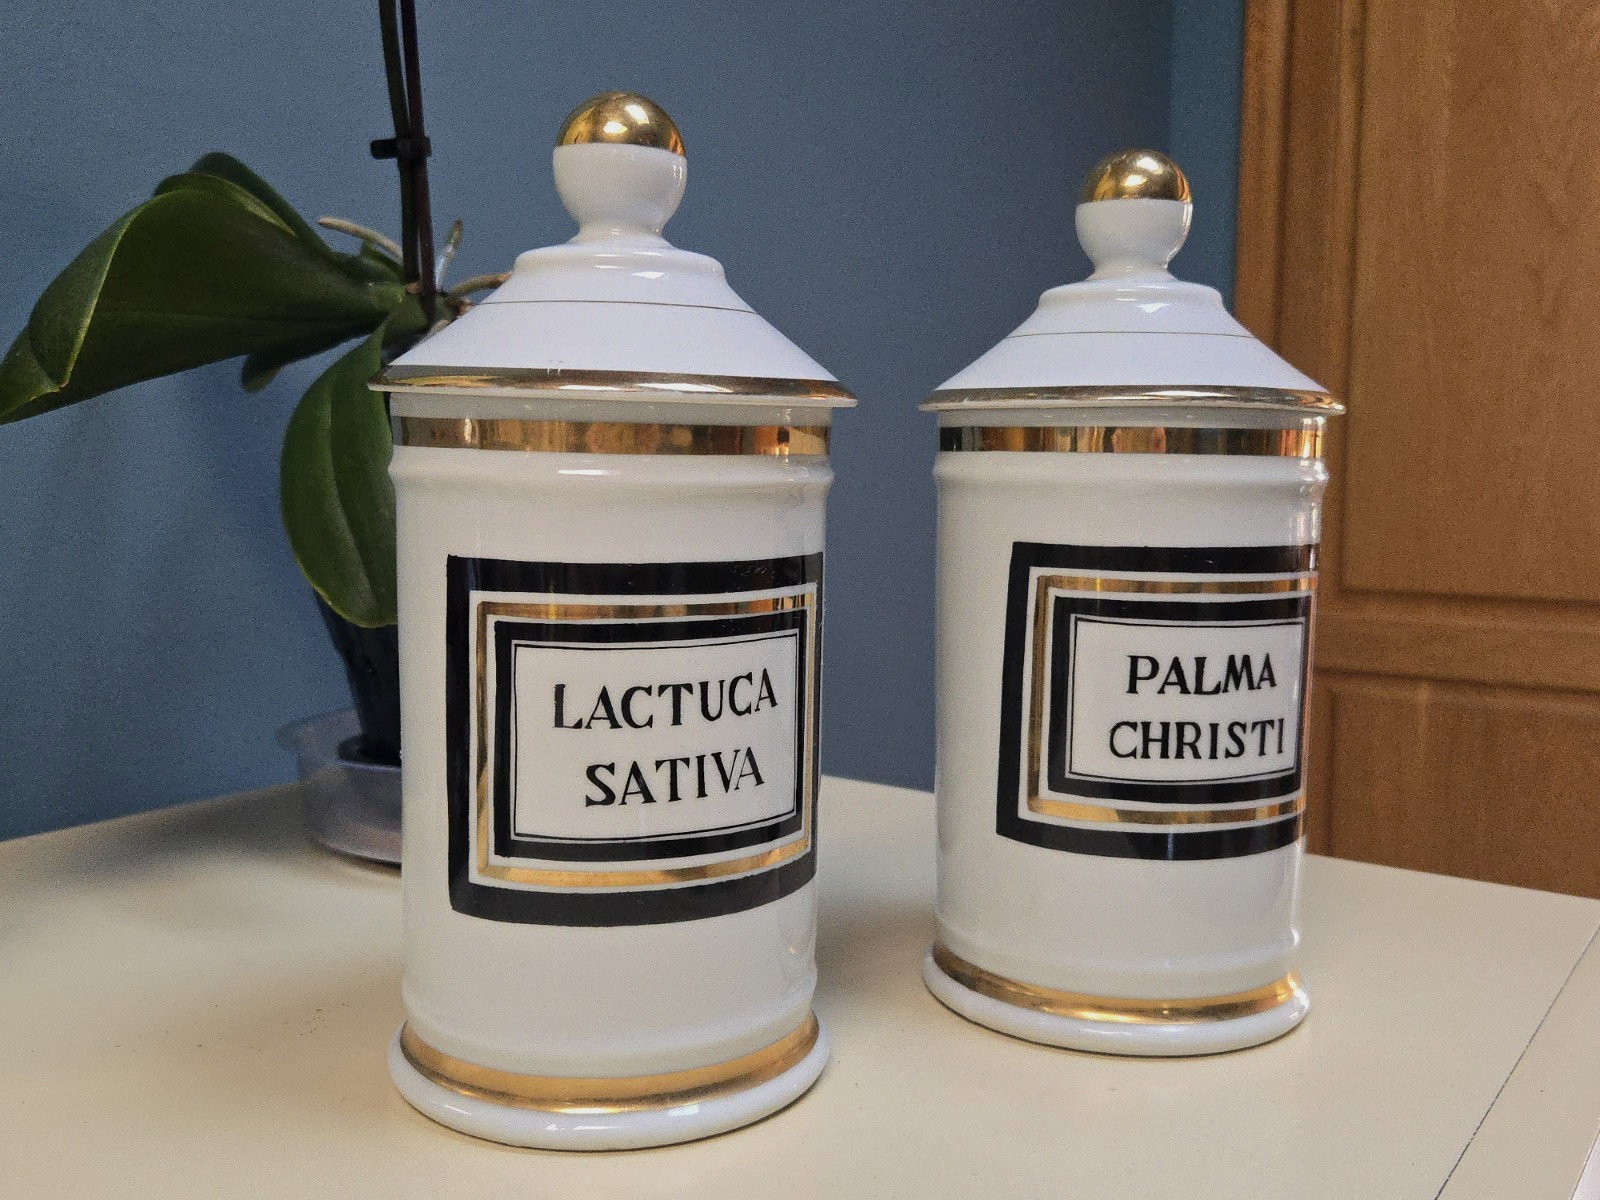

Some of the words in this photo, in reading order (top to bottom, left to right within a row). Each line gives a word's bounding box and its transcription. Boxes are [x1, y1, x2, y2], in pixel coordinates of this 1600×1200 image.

[553, 667, 779, 730] LACTUCA
[1126, 653, 1278, 695] PALMA
[1109, 717, 1285, 760] CHRISTI
[585, 746, 765, 808] SATIVA
